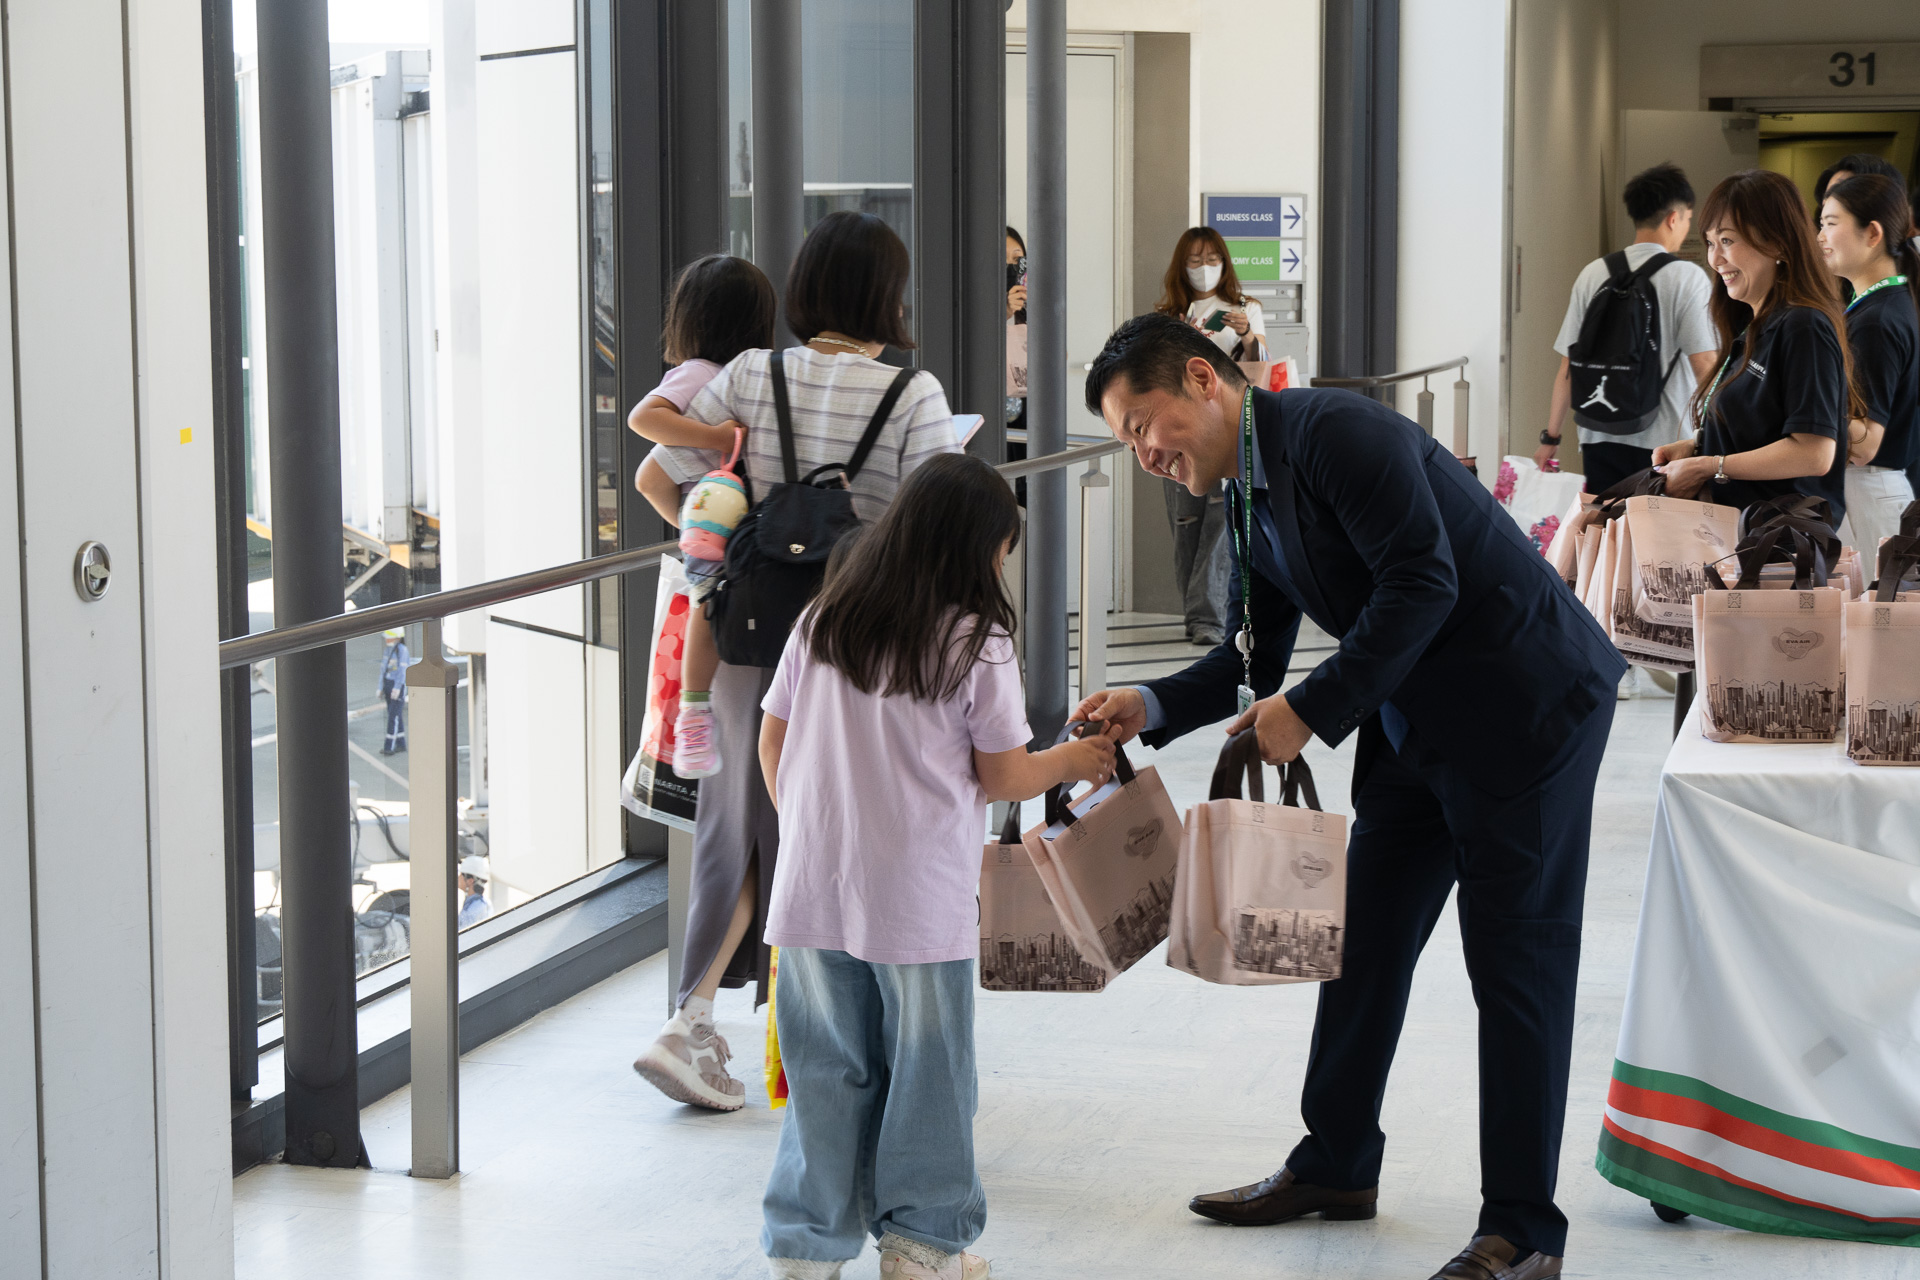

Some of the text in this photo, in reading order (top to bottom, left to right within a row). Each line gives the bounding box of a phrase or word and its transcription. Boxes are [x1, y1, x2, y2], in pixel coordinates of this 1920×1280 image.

[1829, 51, 1875, 88] 31
[1216, 213, 1273, 222] BUSINESS CLASS
[1250, 257, 1273, 265] CLASS
